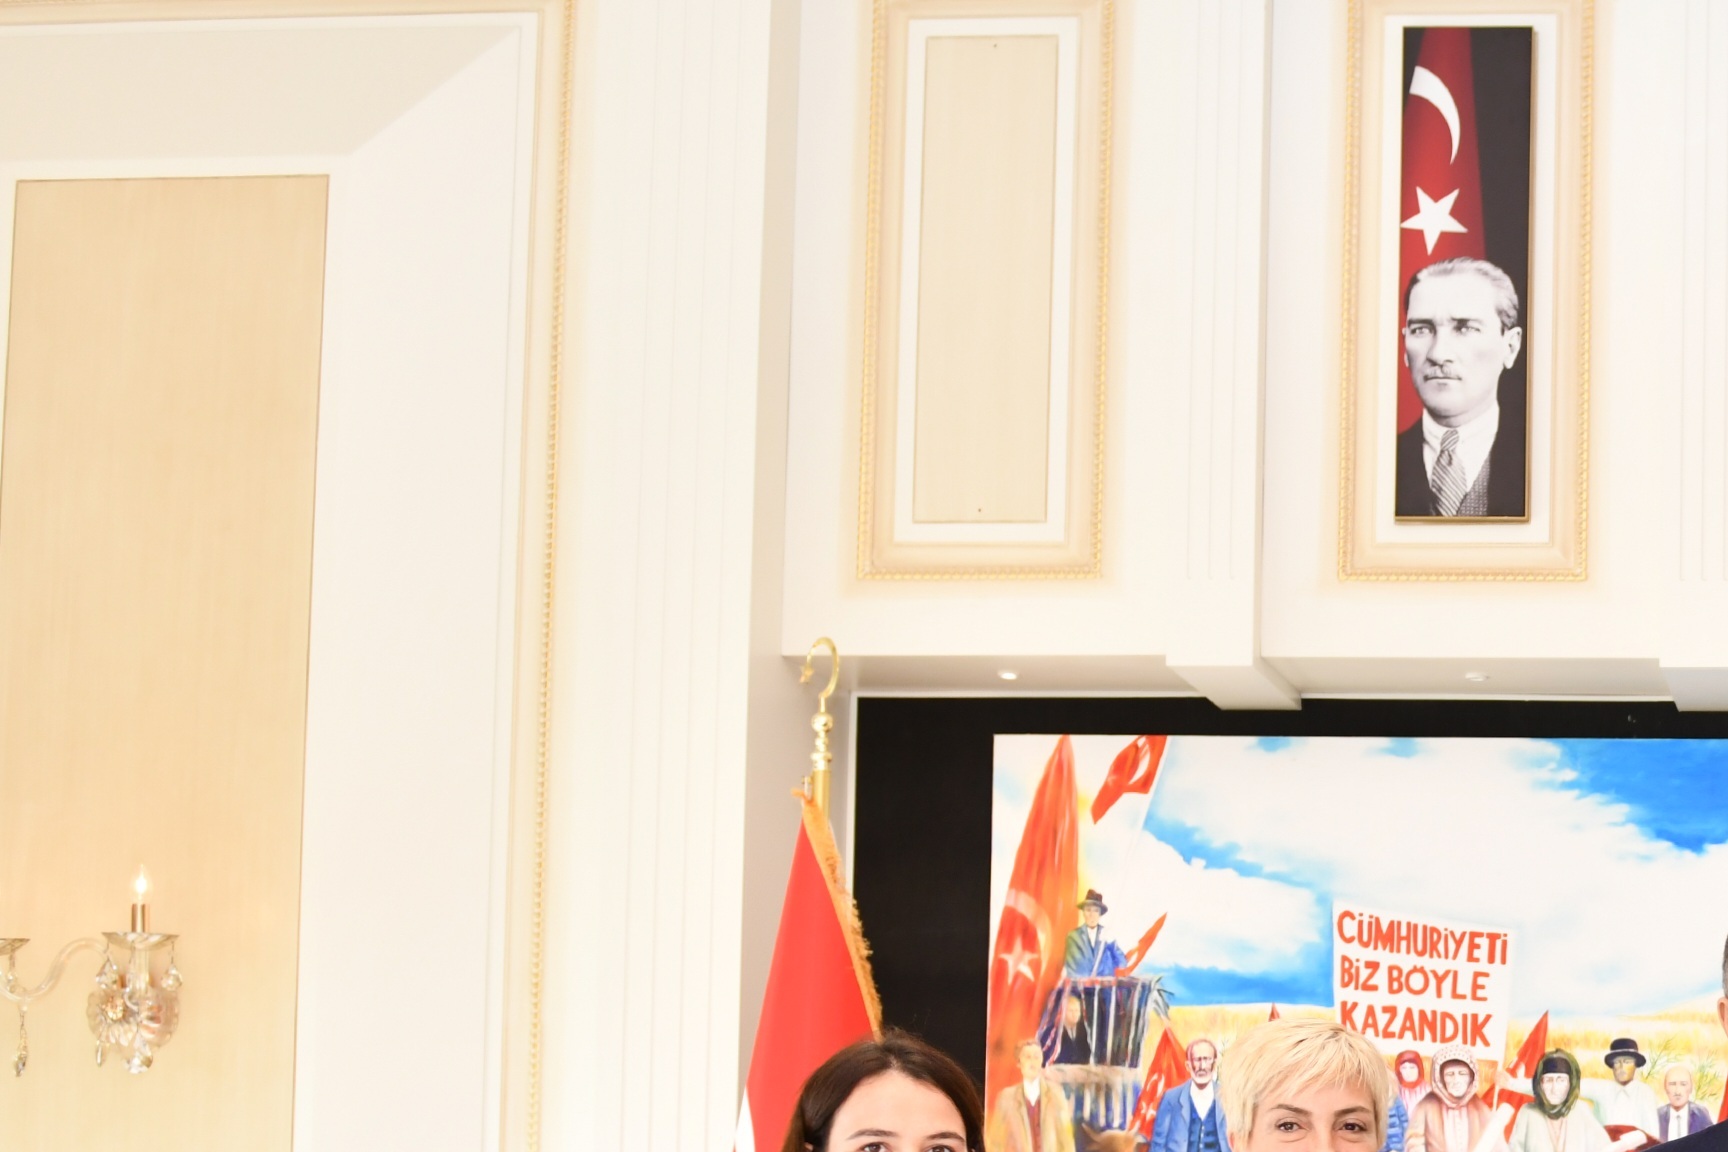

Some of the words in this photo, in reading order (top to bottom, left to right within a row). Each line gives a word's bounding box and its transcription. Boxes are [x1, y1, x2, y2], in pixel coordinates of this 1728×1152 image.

[1337, 910, 1508, 965] CÜMHURİYETİ
[1340, 955, 1380, 992] BİZ
[1387, 965, 1490, 1001] BÖYLE
[1340, 1001, 1492, 1047] KAZANDIK
